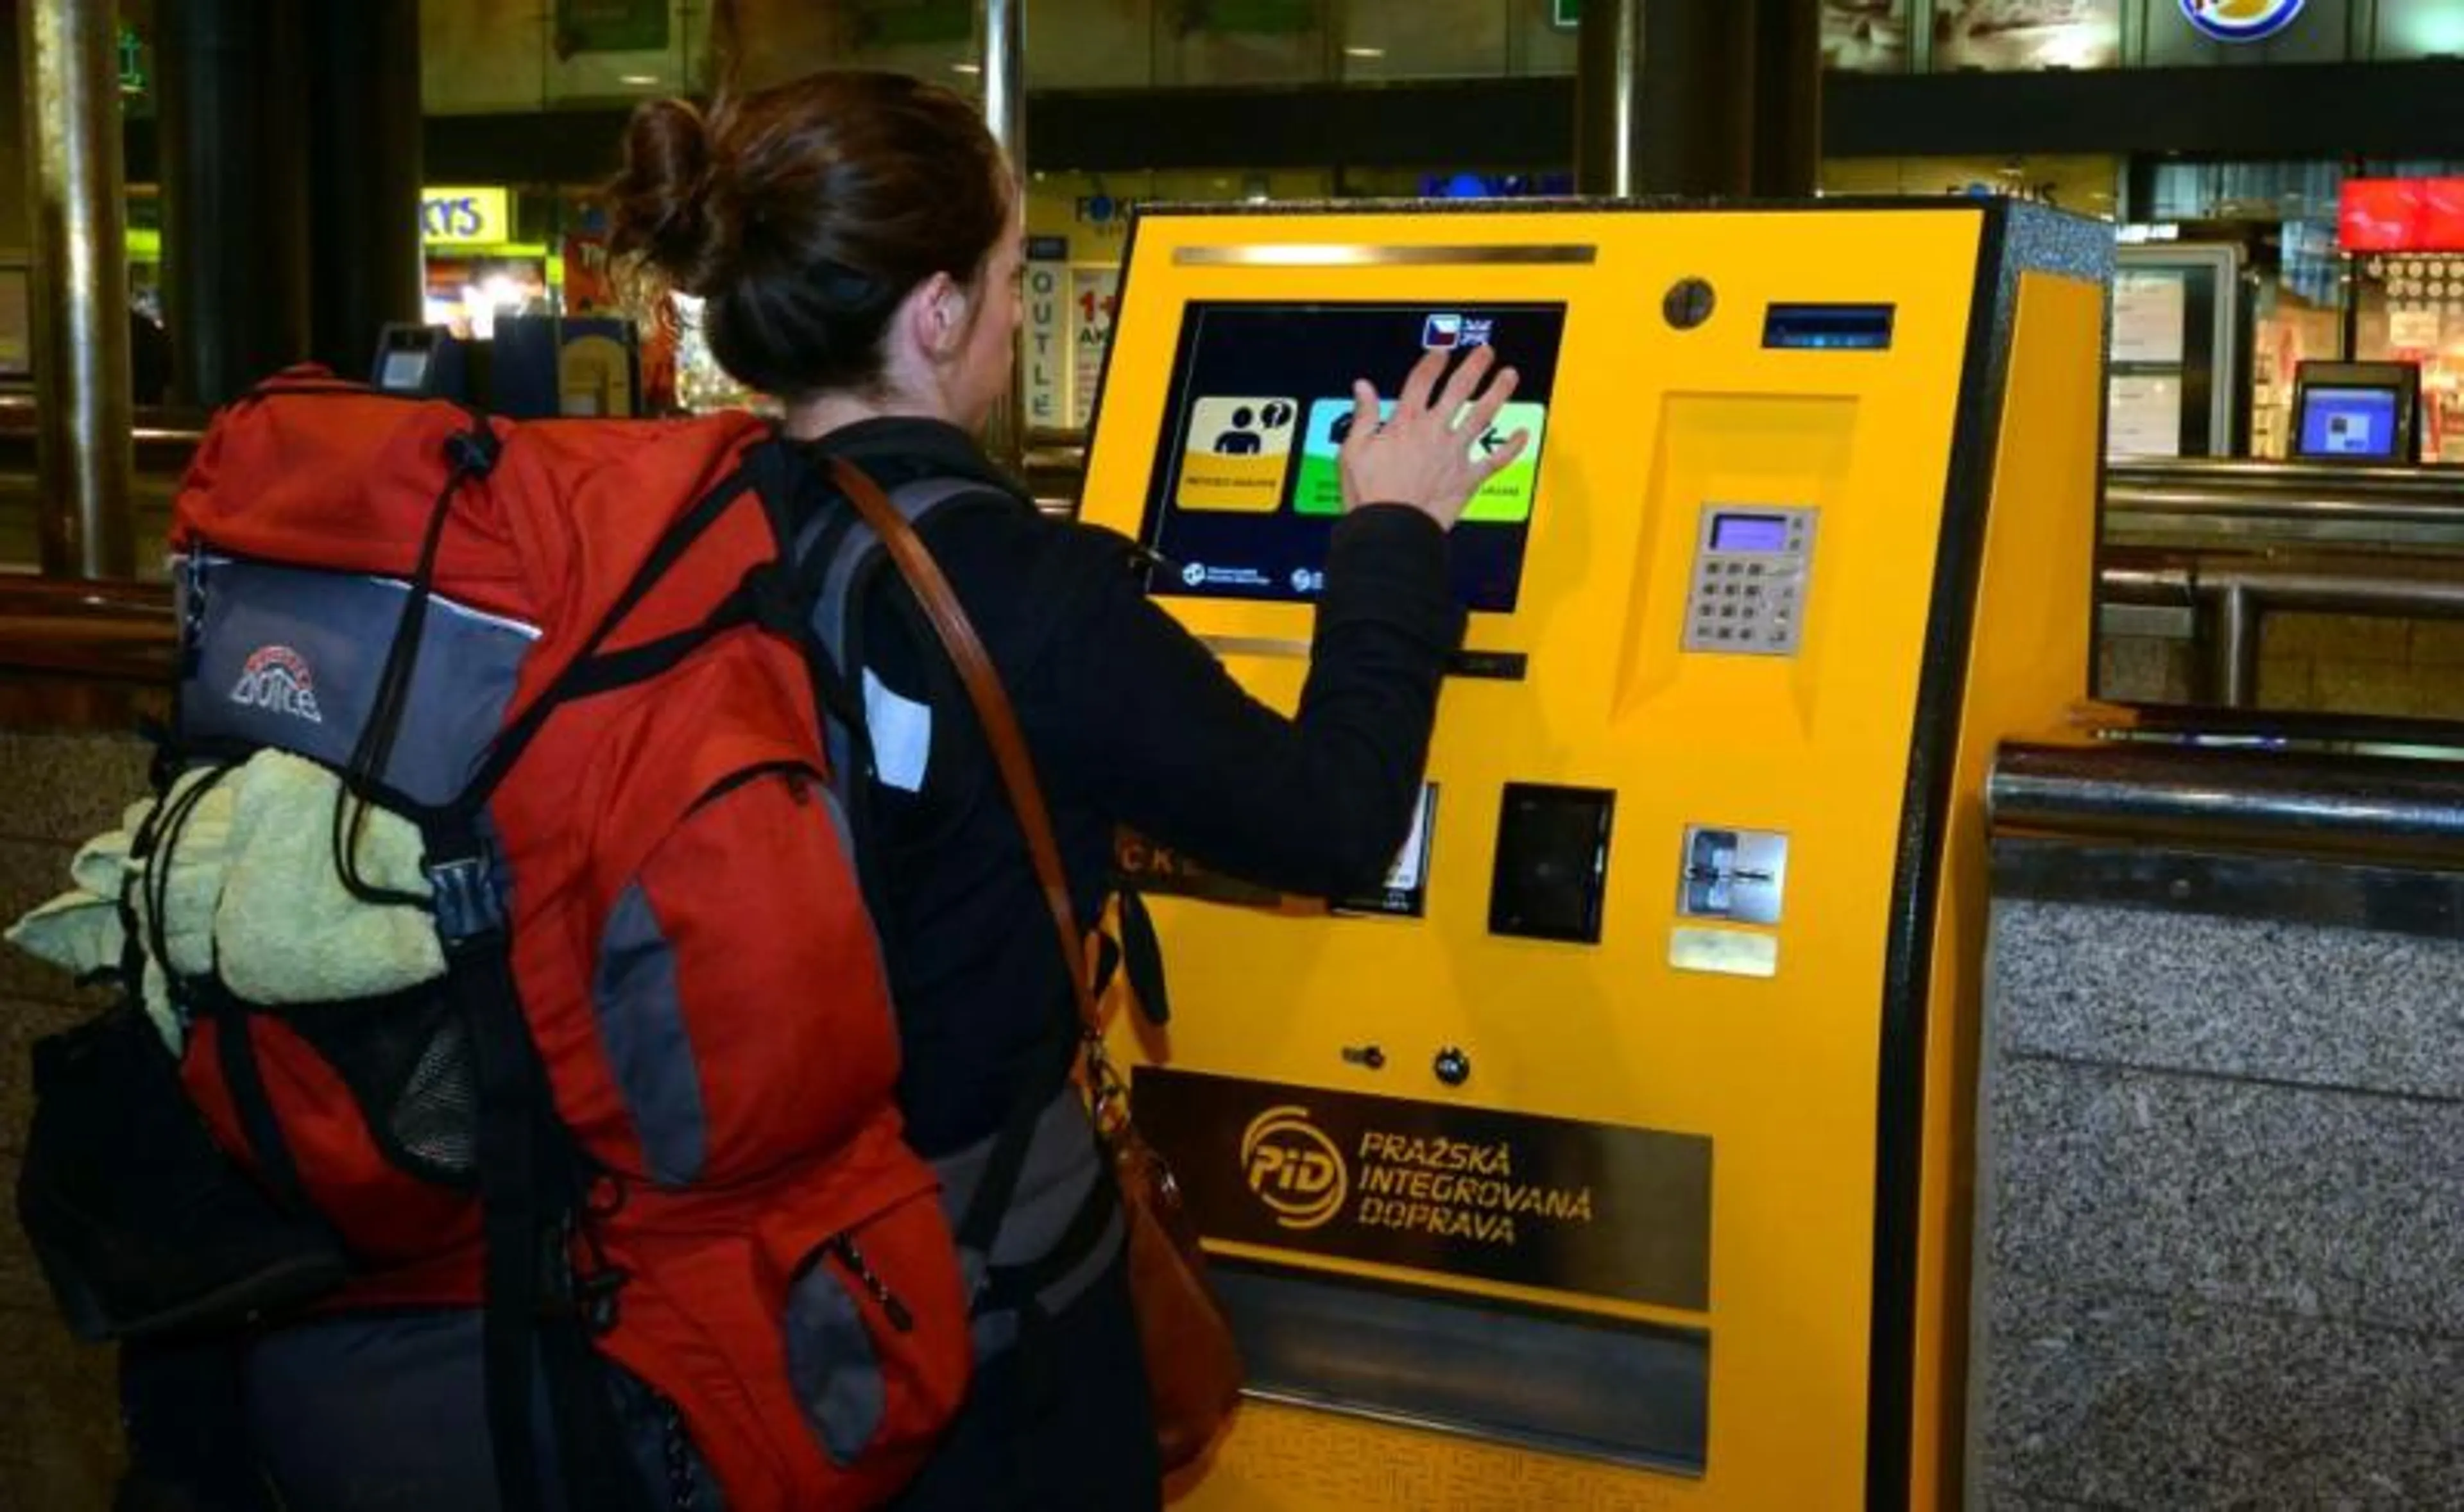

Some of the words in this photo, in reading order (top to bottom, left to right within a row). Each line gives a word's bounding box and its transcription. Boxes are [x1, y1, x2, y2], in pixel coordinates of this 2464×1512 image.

[1358, 1130, 1510, 1176] PRAŽSKÁ
[1358, 1164, 1592, 1221] INTEGROVANÁ
[1358, 1196, 1516, 1246] DOPRAVA
